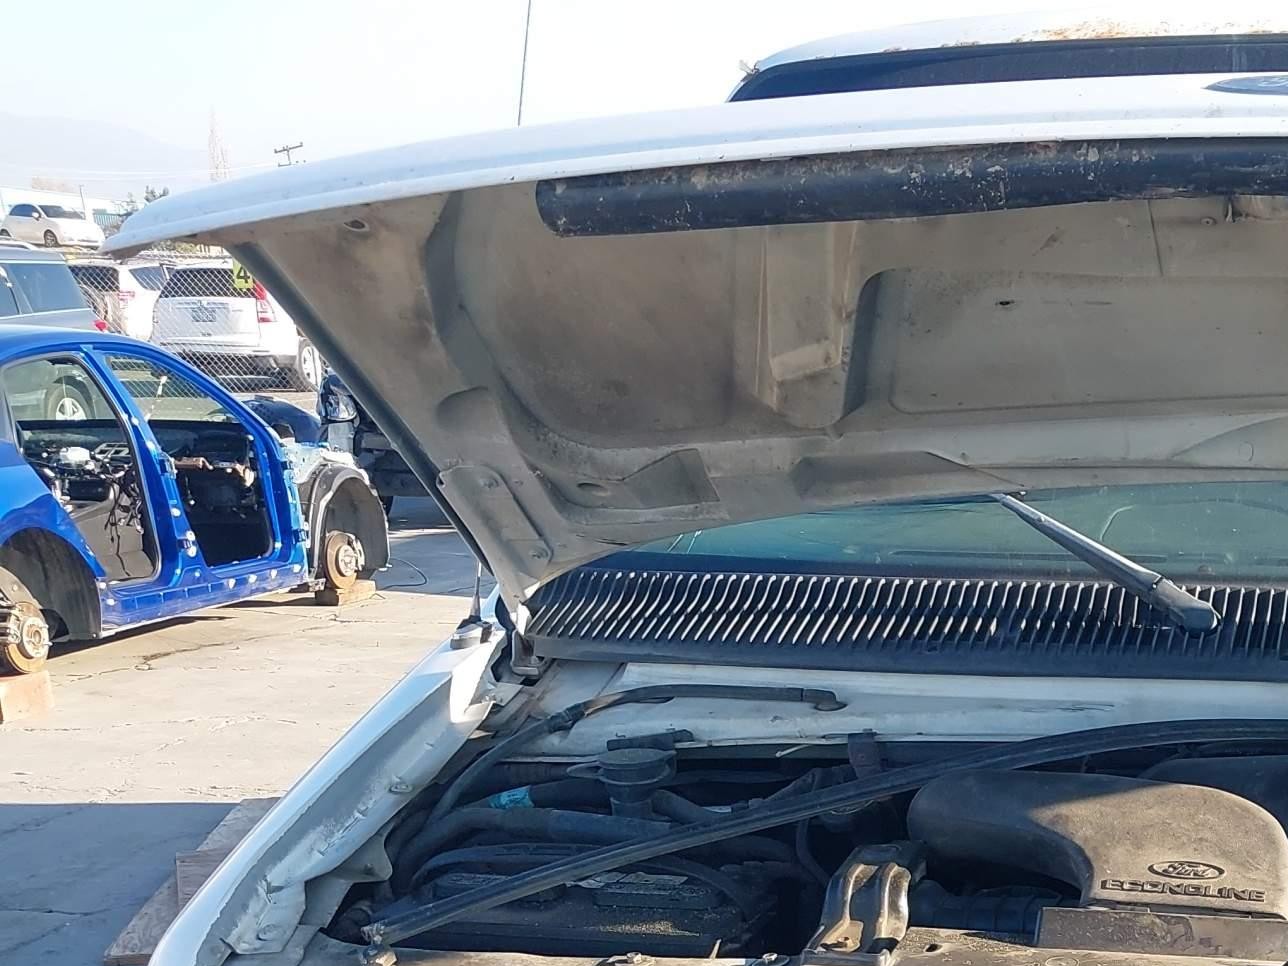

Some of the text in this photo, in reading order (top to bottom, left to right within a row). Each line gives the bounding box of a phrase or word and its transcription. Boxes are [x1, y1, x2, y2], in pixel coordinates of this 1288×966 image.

[236, 266, 251, 284] 4
[1161, 861, 1212, 878] Ford
[1100, 879, 1266, 902] ECONOLINE
